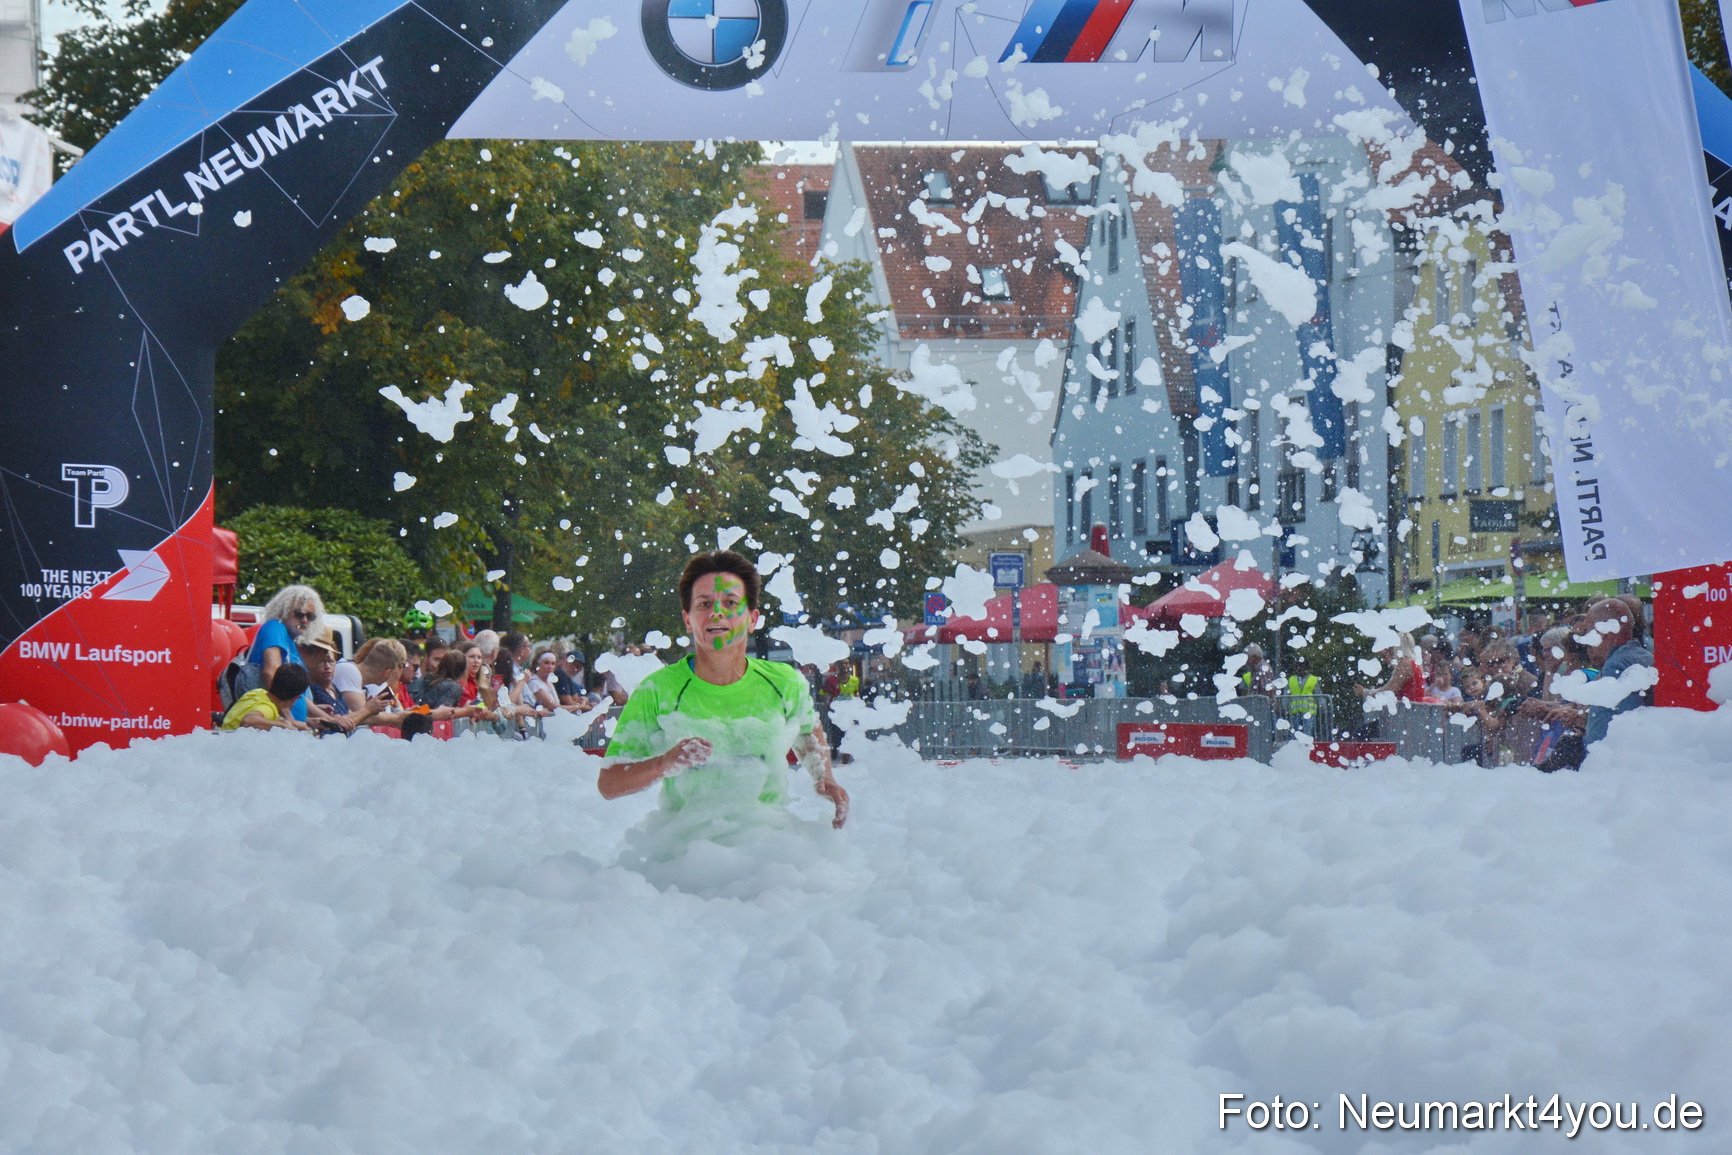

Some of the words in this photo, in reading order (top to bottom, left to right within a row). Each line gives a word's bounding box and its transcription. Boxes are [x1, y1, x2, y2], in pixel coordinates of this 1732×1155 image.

[62, 187, 189, 275] PARTL
[183, 55, 389, 201] NEUMARKT
[66, 468, 87, 476] Team
[41, 569, 69, 584] THE
[72, 569, 111, 585] NEXT
[20, 583, 42, 597] 100
[44, 583, 93, 599] YEARS
[19, 640, 70, 660] BMW
[75, 643, 171, 666] Laufsport
